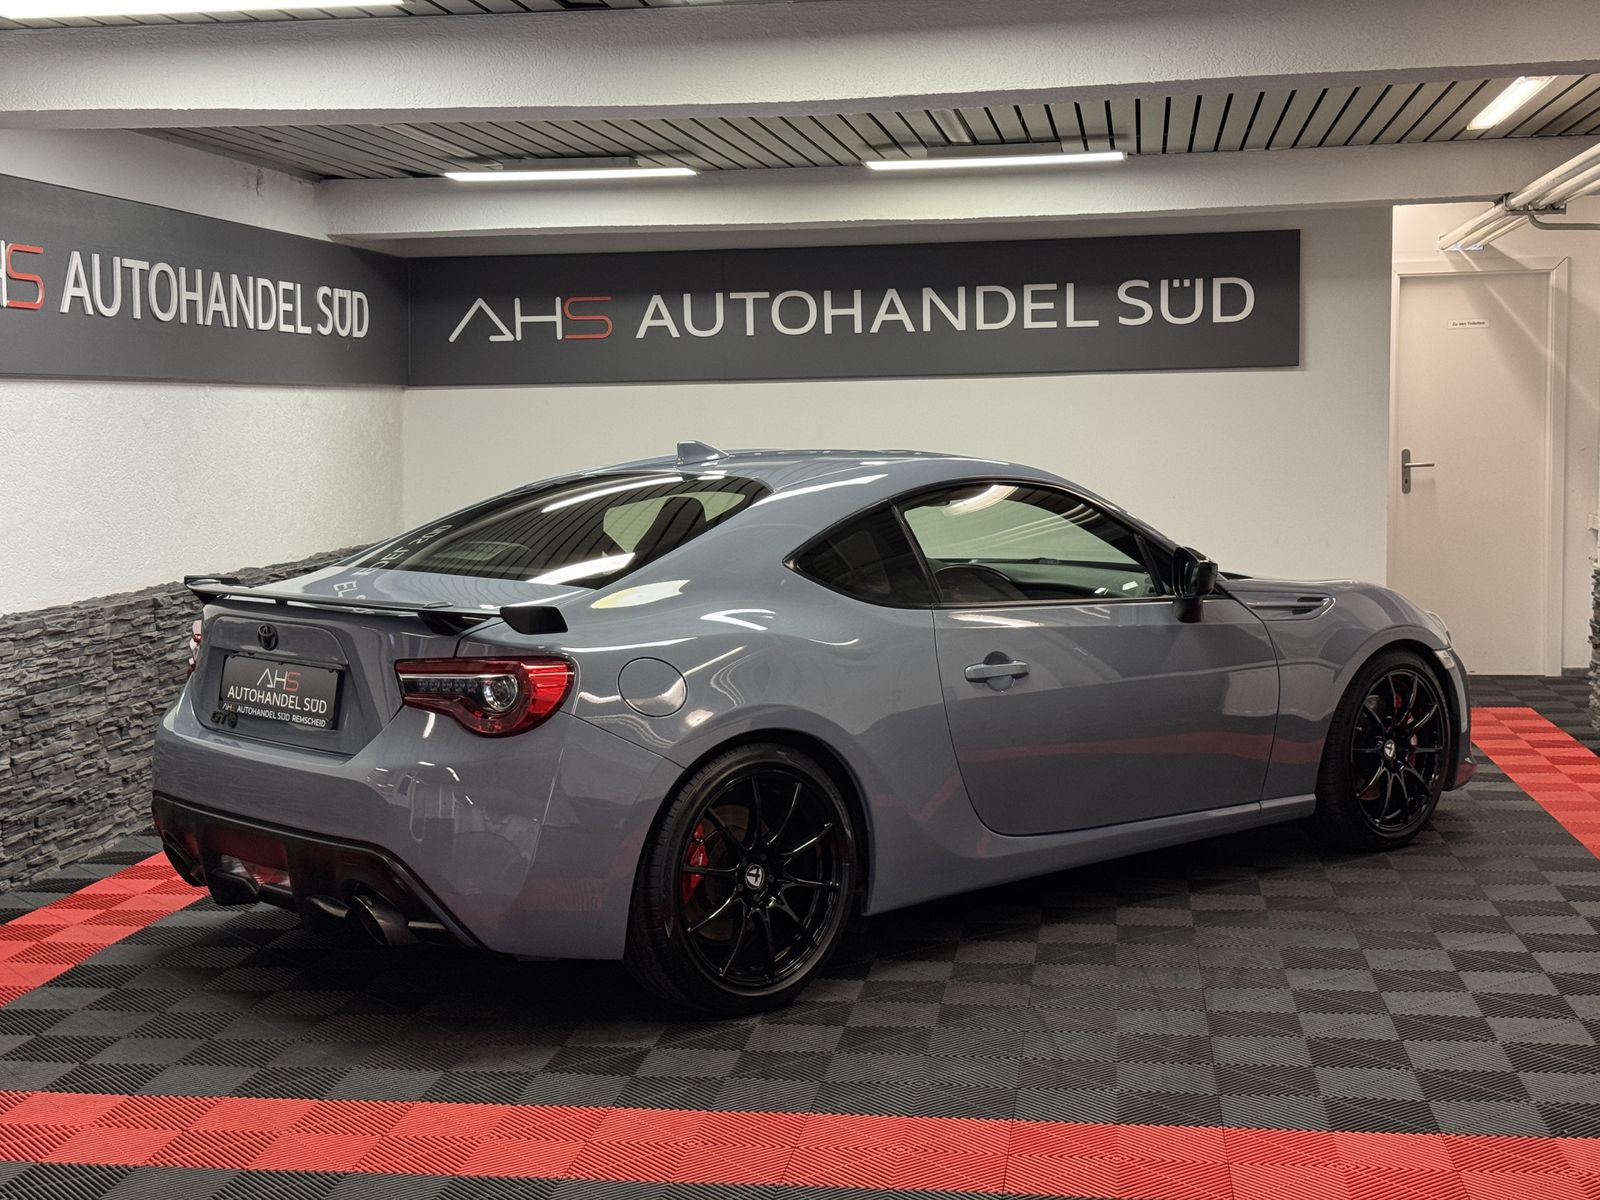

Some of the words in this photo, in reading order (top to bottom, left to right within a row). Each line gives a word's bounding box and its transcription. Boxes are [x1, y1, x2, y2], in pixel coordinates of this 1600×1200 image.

[59, 250, 313, 335] AUTOHANDEL
[316, 285, 370, 339] SÜD
[448, 296, 613, 343] AHS
[635, 281, 1100, 340] AUTOHANDEL
[1116, 276, 1256, 326] SÜD
[256, 667, 302, 692] AHS
[227, 685, 301, 711] AUTOHANDEL
[303, 696, 327, 714] SÜD
[237, 706, 276, 720] AUTOHANDEL
[291, 714, 326, 728] REMSCHEID
